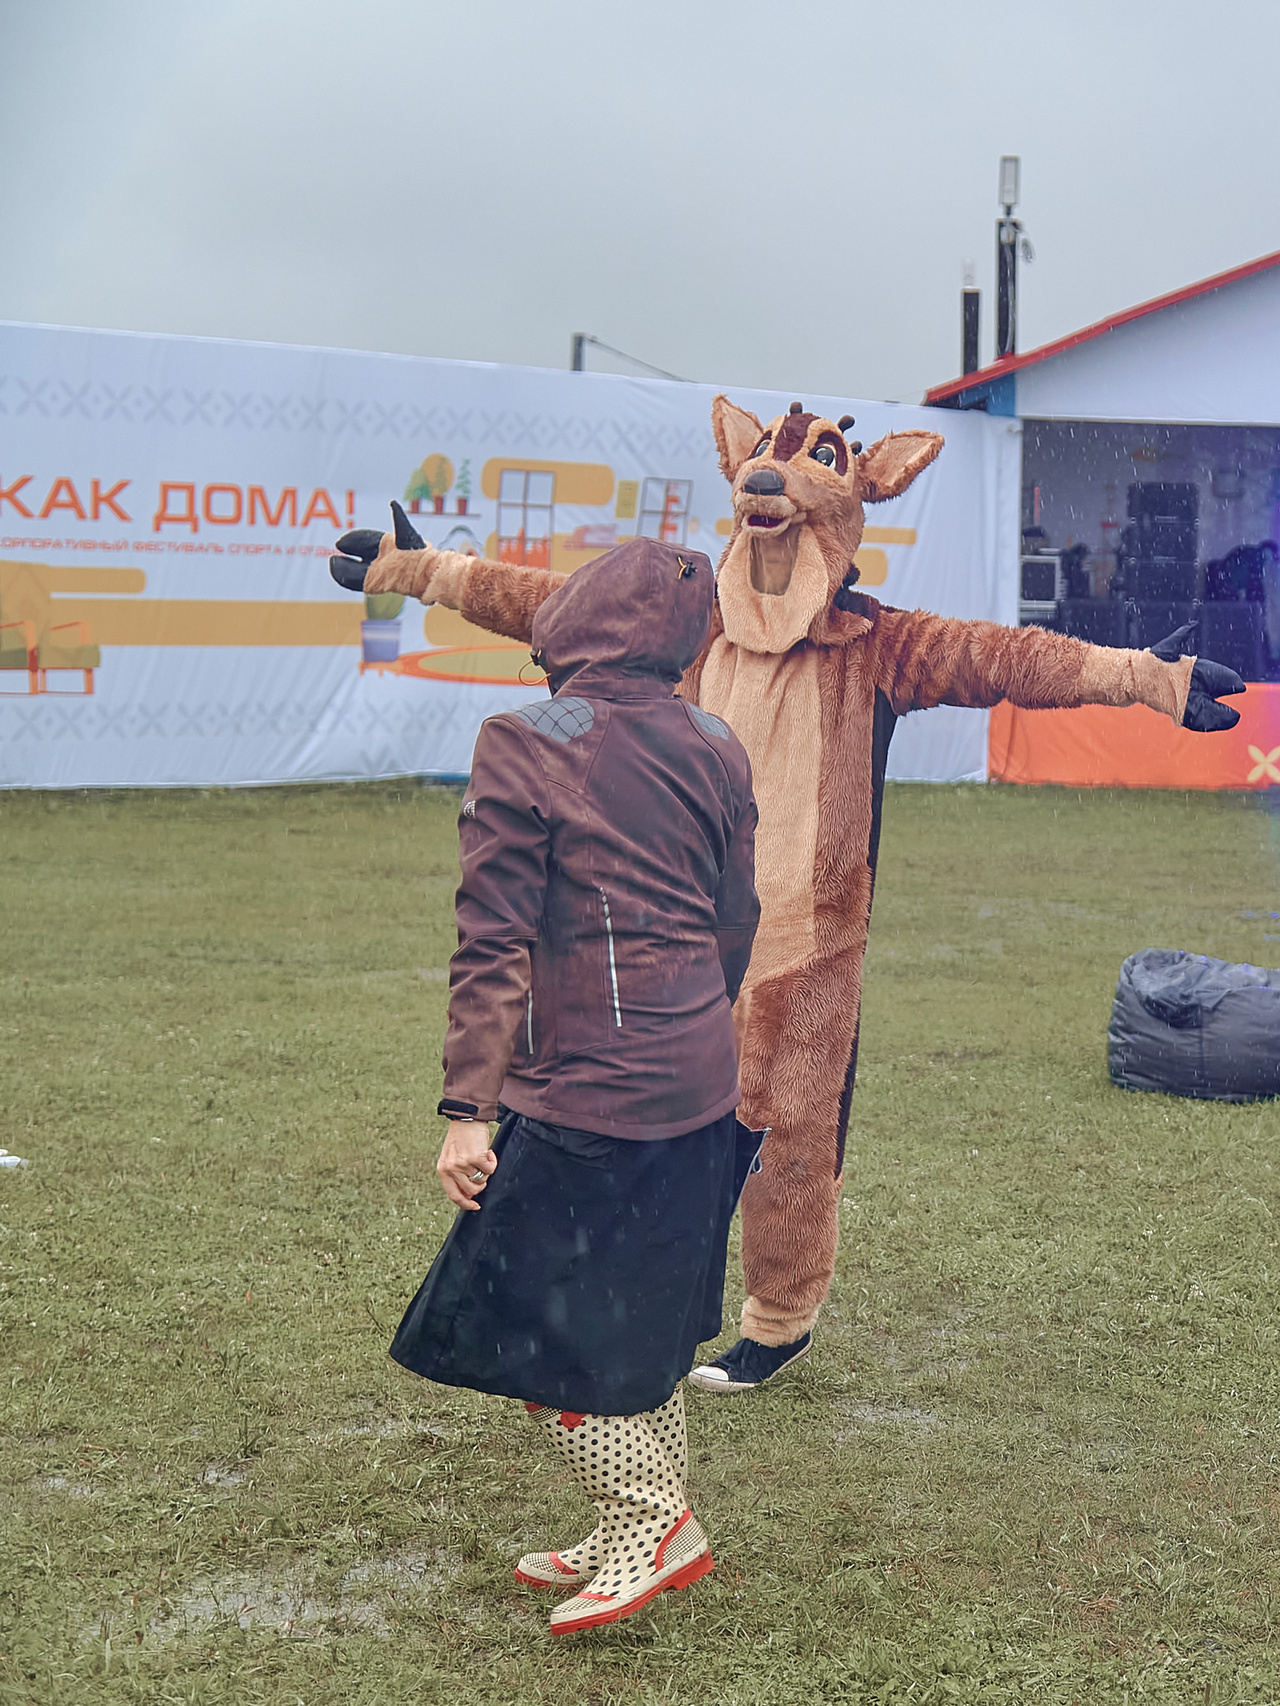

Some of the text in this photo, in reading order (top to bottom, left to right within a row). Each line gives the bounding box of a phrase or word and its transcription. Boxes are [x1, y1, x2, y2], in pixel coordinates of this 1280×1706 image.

[0, 474, 356, 533] КАК ДОМА!
[0, 536, 129, 551] ОРПОРАТИВНЫЙ
